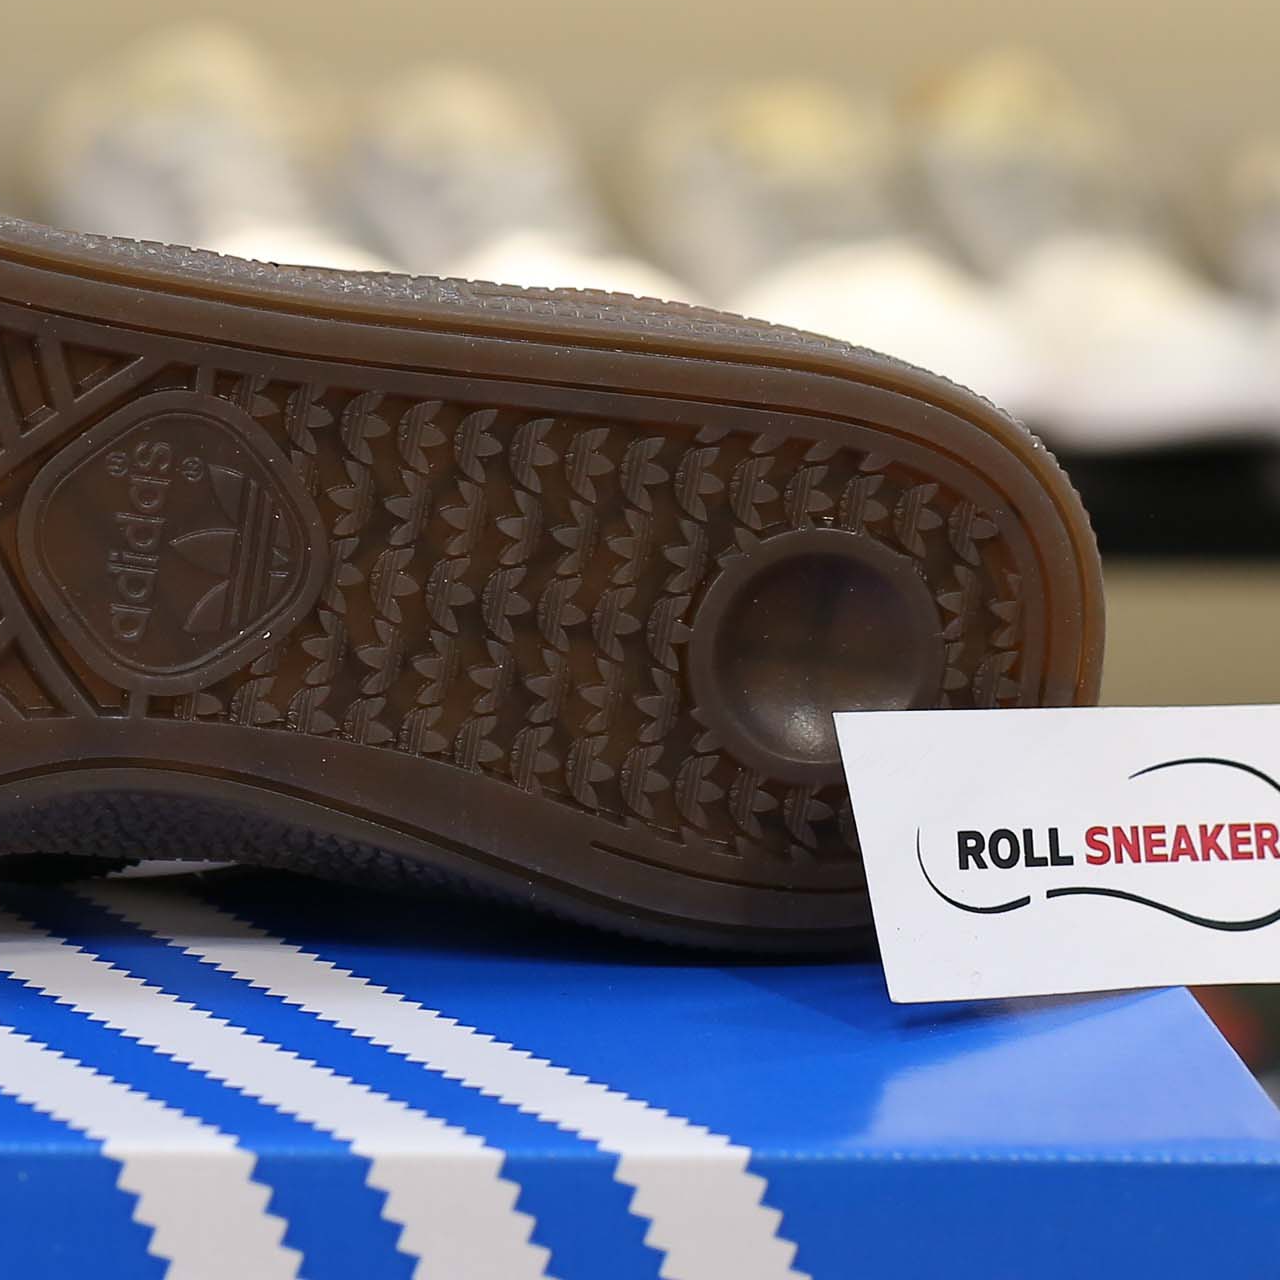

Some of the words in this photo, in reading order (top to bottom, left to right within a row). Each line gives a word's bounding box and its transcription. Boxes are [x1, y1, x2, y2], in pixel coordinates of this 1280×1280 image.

[108, 440, 171, 641] adidas
[957, 827, 1074, 870] ROLL
[1085, 822, 1280, 865] SNEAKER
